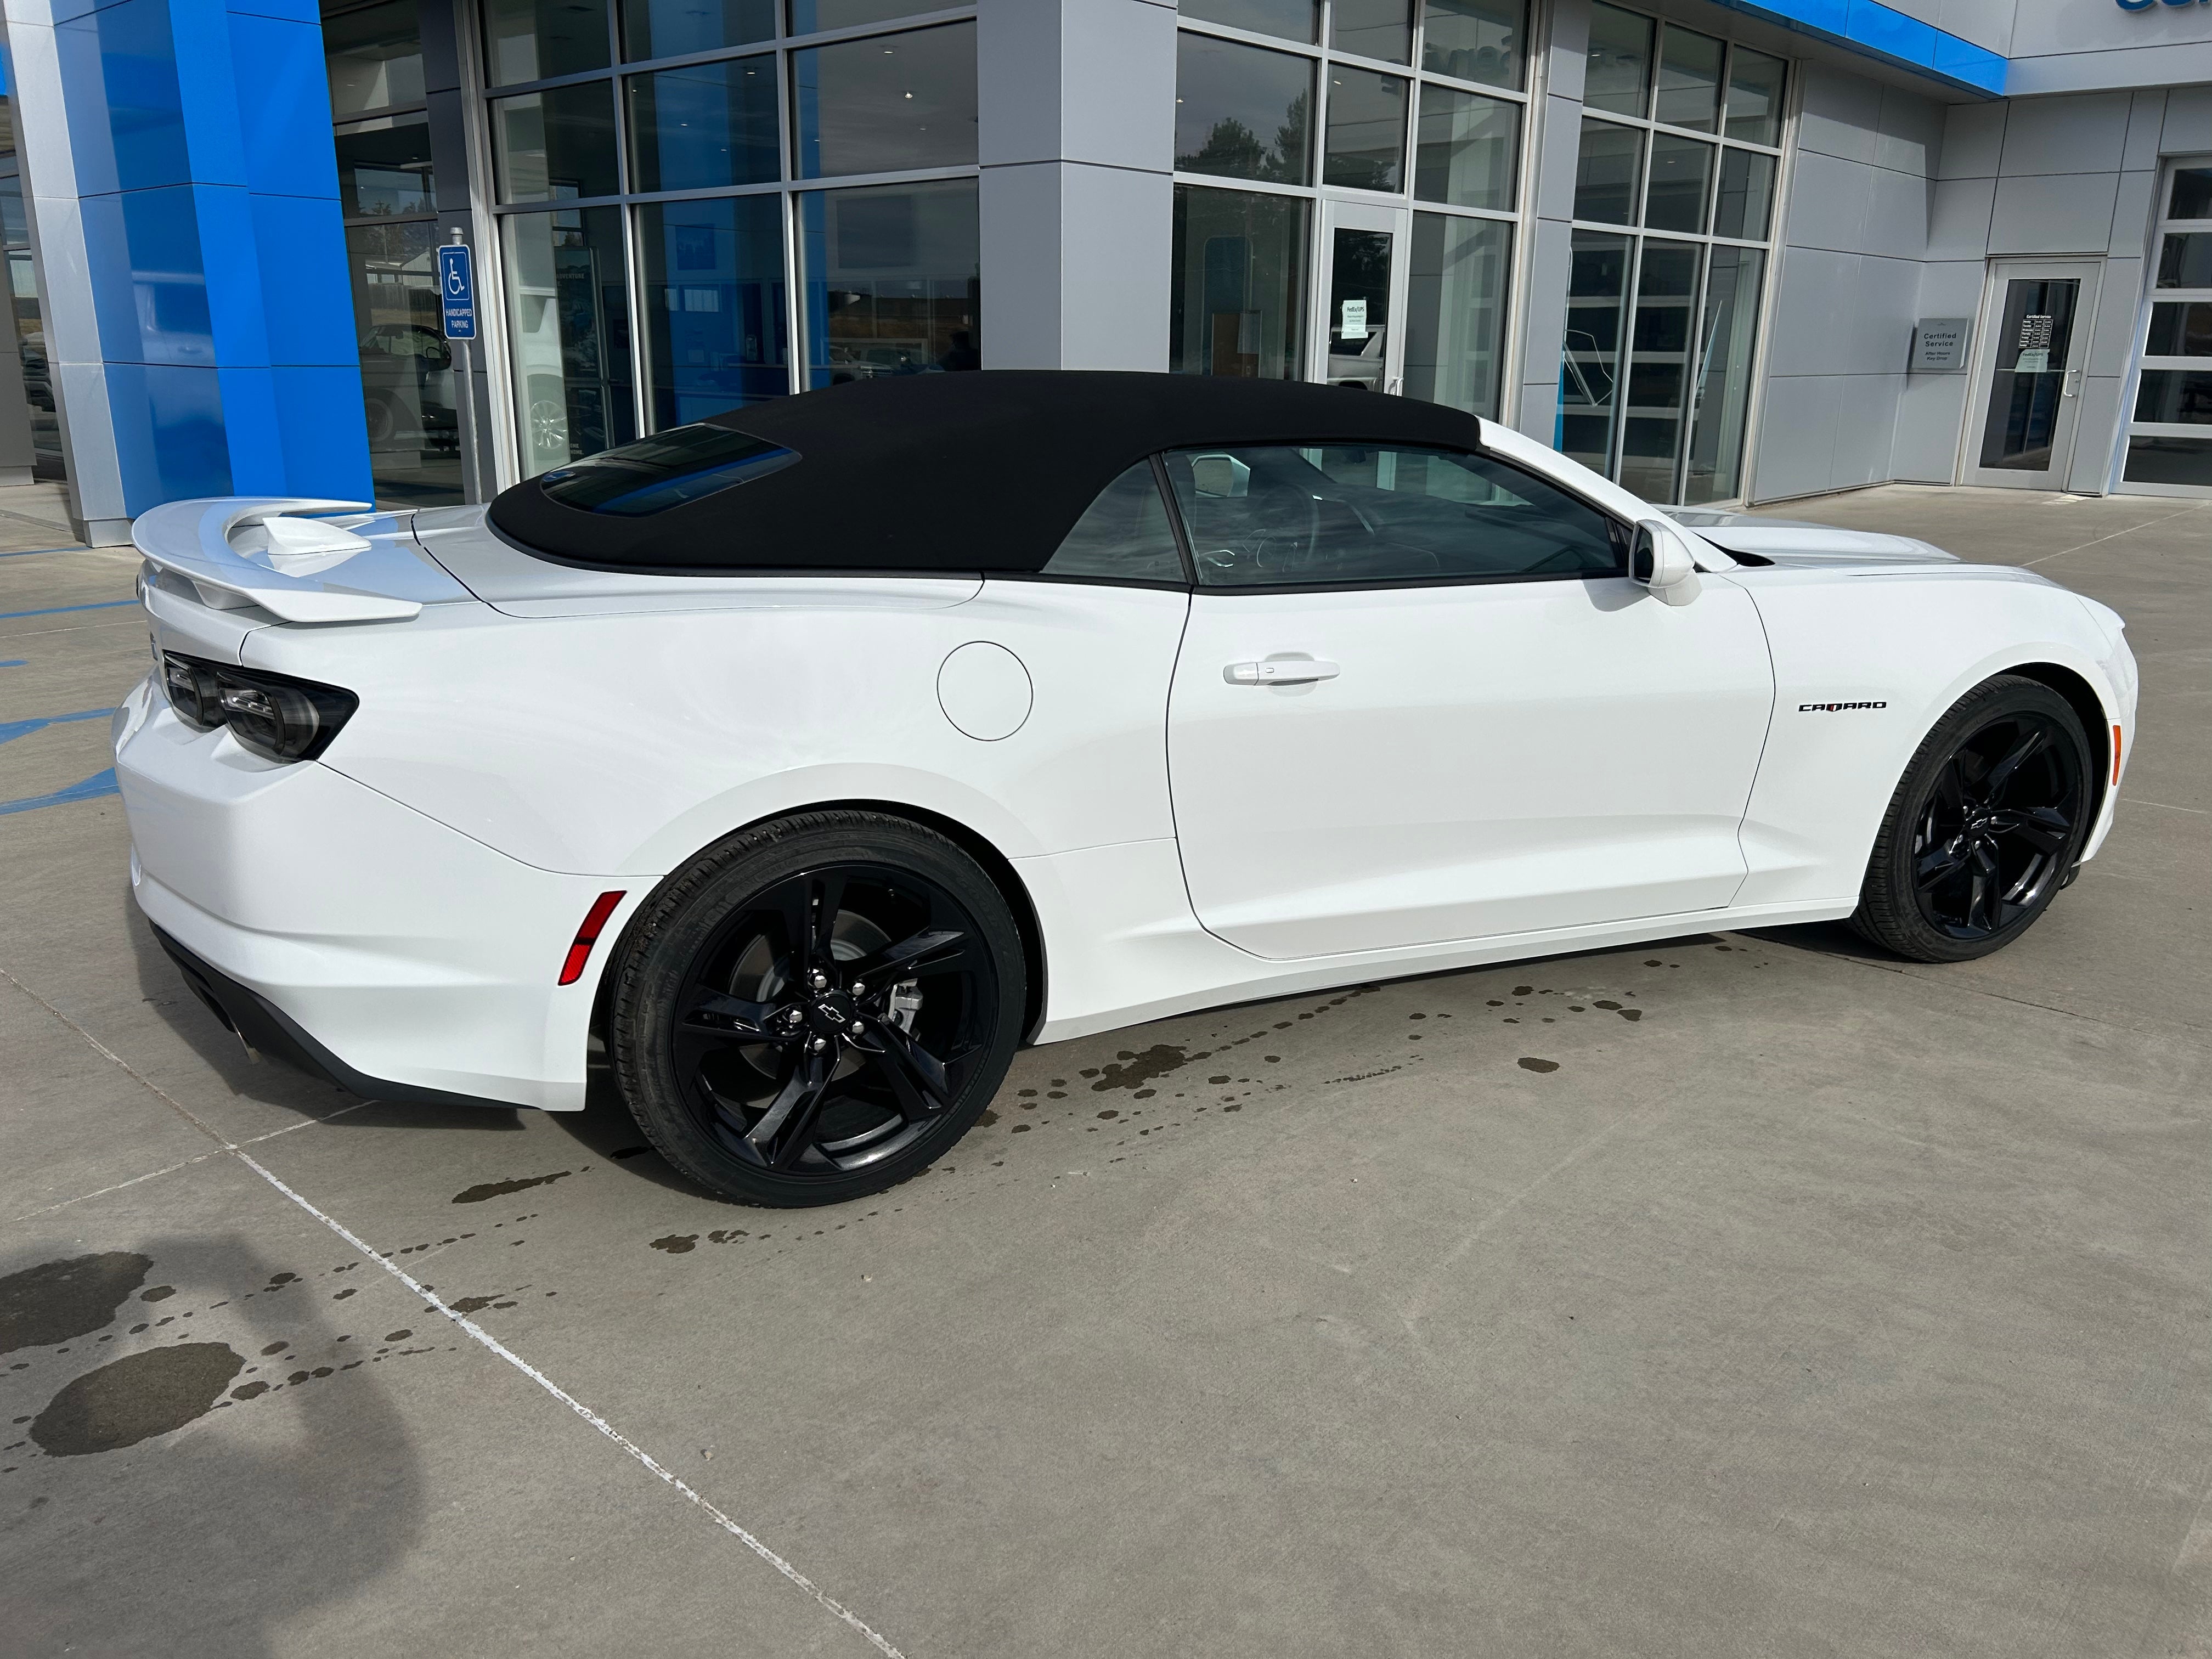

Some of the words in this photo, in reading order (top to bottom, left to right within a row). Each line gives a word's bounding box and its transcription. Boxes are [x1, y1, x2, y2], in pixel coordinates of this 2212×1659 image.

[445, 308, 472, 317] HANDICAPPED
[451, 320, 469, 329] PARKING
[1798, 702, 1887, 712] CAMARO
